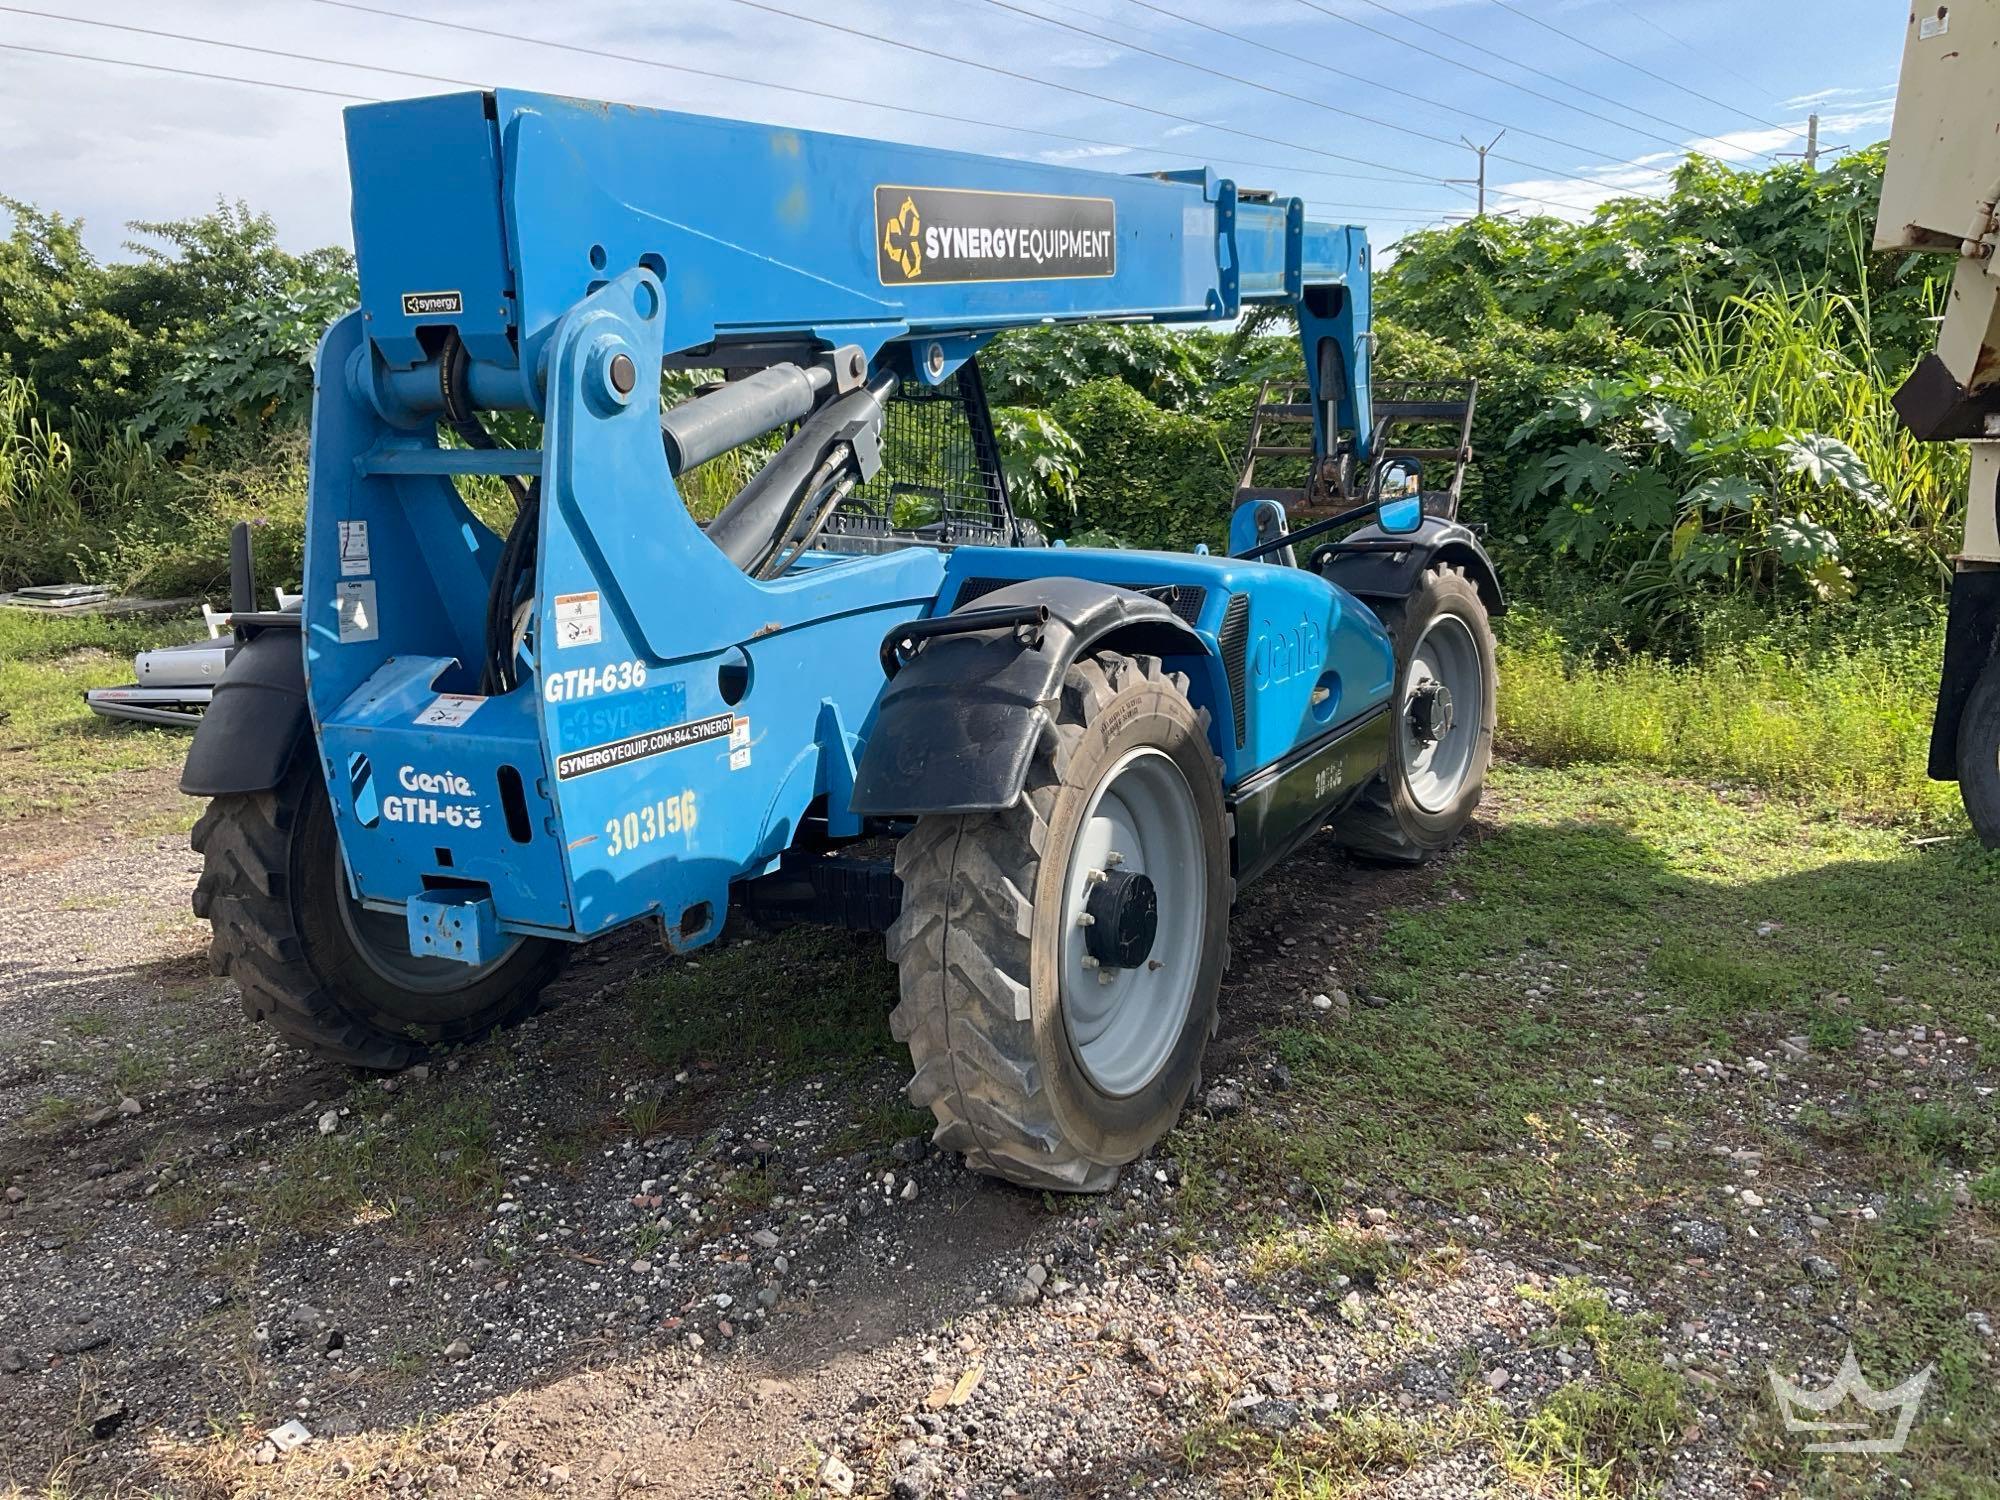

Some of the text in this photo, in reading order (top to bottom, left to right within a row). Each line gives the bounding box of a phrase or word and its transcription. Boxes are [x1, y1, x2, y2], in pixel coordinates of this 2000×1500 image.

[420, 297, 458, 311] synergy
[545, 660, 647, 703] GTH-636
[399, 765, 473, 797] Genie
[605, 788, 698, 857] 303156
